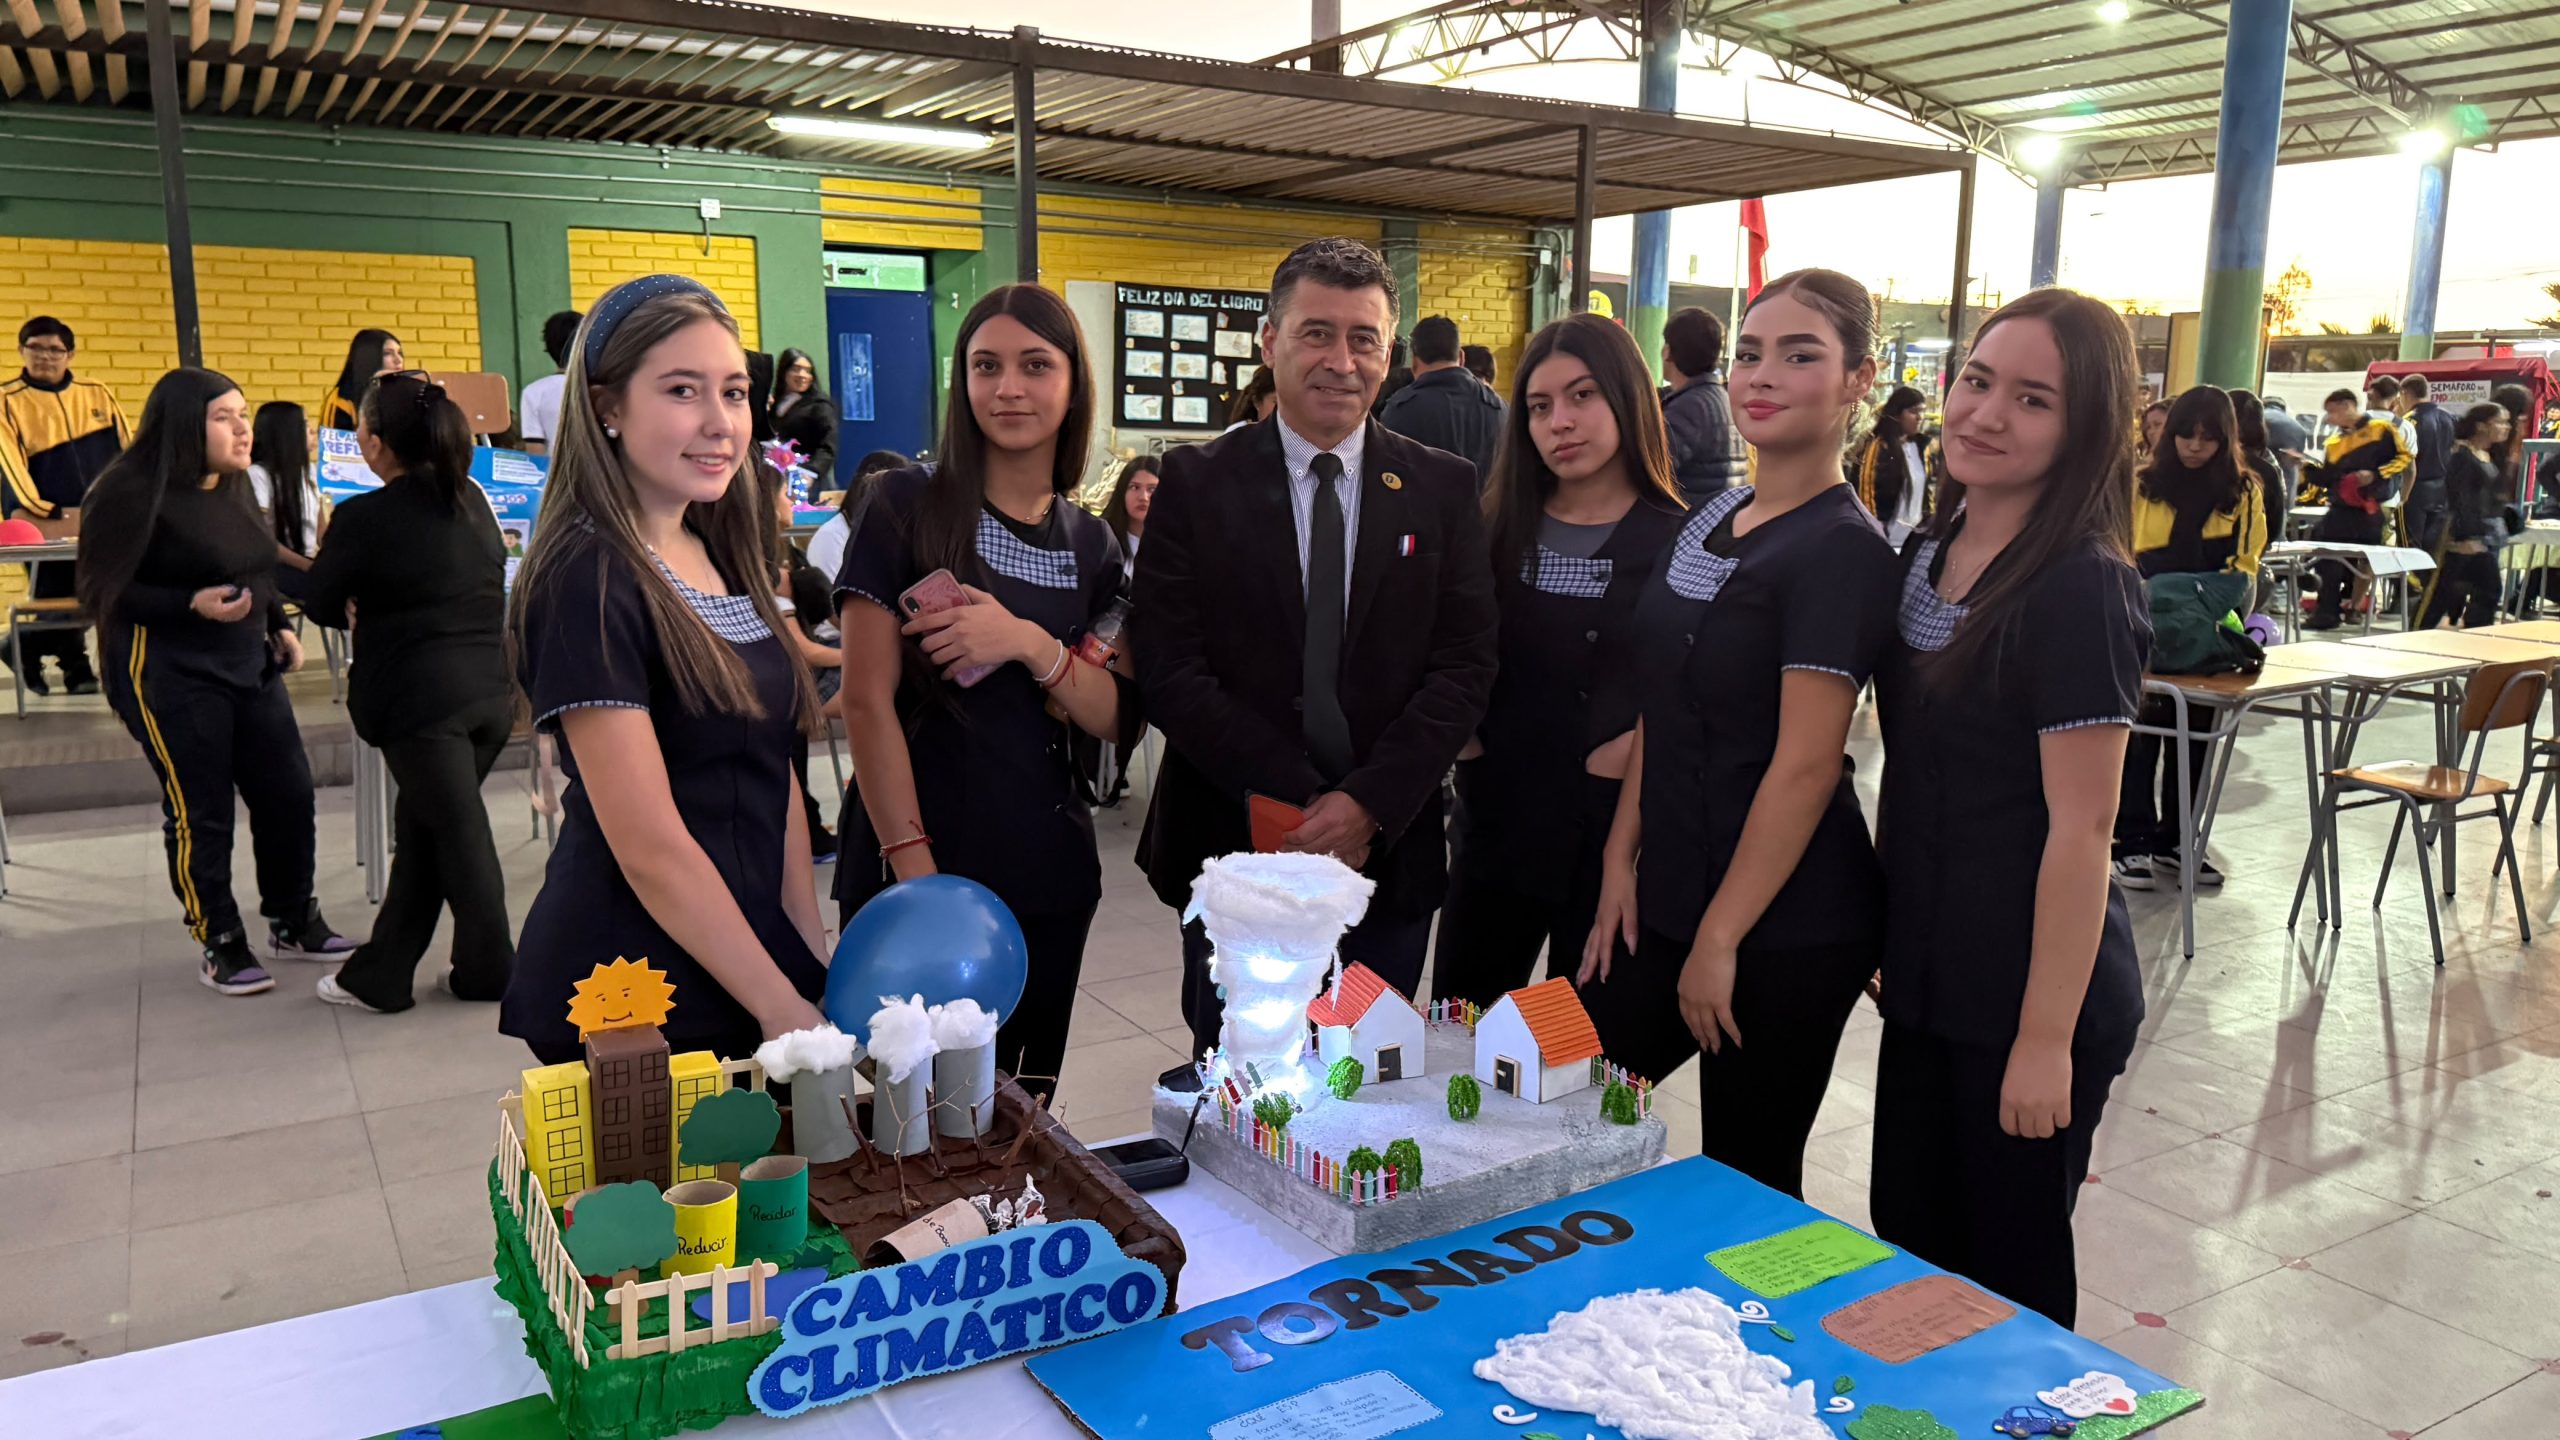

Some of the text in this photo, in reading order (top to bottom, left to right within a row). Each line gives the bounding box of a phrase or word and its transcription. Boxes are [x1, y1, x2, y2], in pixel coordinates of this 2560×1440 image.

[1118, 286, 1160, 305] FELIZ
[1189, 292, 1217, 308] DEL
[1220, 294, 1263, 312] LIBRO
[325, 441, 363, 455] REFL
[345, 431, 359, 443] AR
[923, 1217, 936, 1228] de
[791, 1226, 1091, 1337] CAMBIO
[1180, 1210, 1634, 1373] TORNADO
[760, 1271, 1157, 1411] CLIMÁTICO
